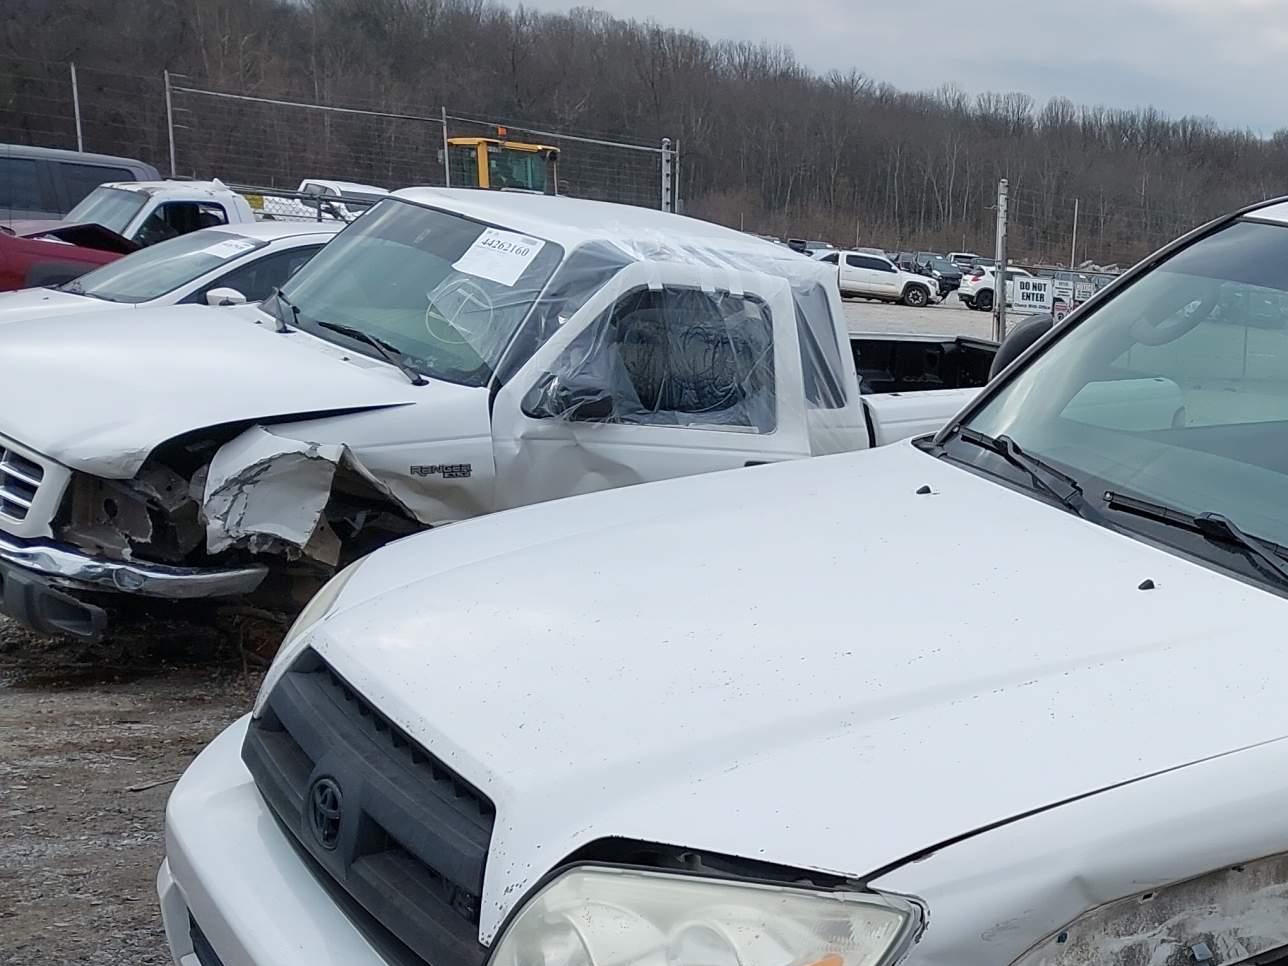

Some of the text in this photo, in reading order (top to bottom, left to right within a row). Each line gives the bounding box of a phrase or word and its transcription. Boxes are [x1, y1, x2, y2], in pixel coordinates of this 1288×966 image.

[481, 238, 530, 256] 44262160
[1020, 281, 1030, 290] DO
[1032, 281, 1047, 292] NOT
[1022, 291, 1045, 302] ENTER
[410, 464, 472, 477] RANGER
